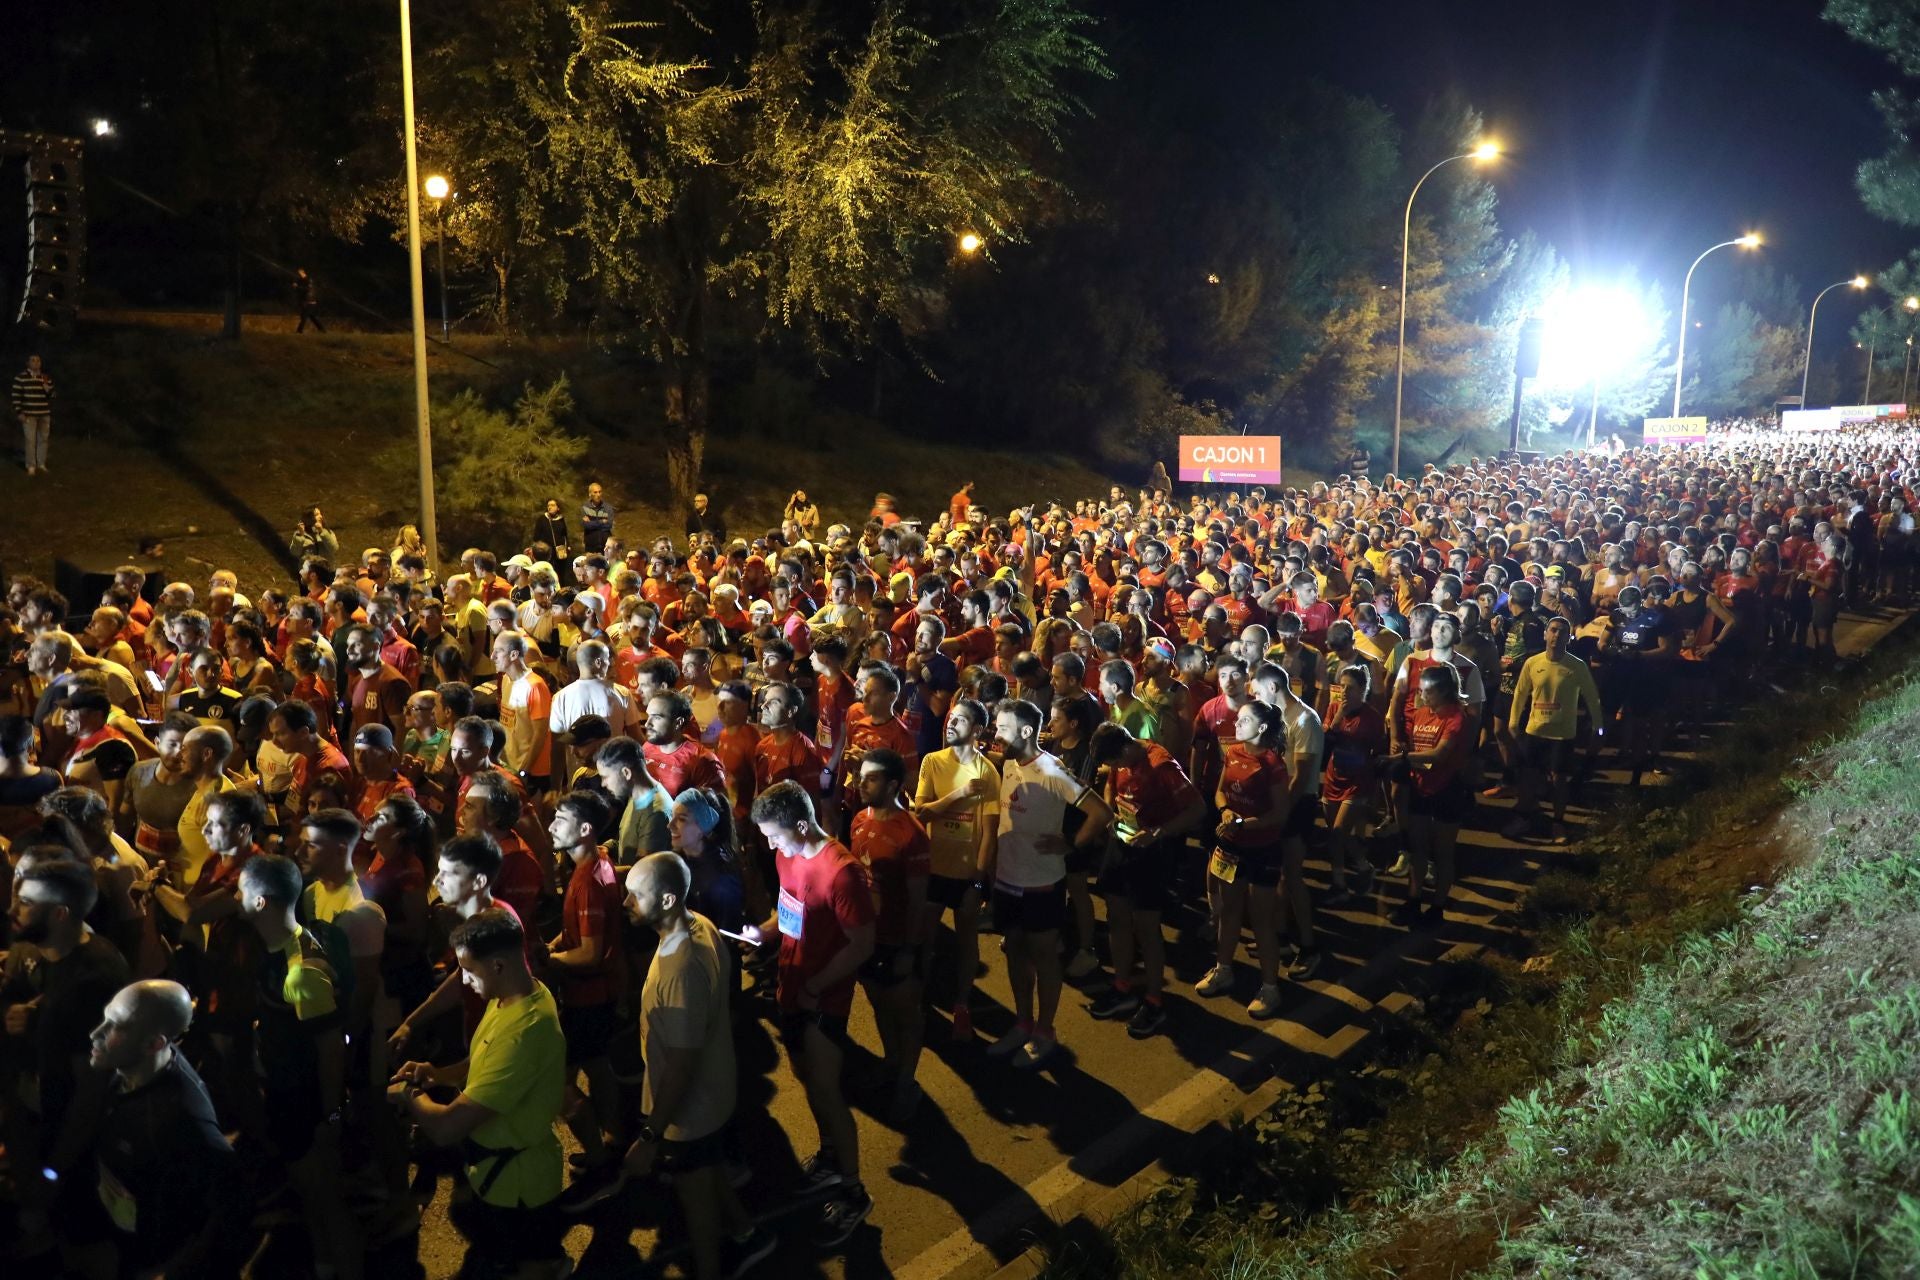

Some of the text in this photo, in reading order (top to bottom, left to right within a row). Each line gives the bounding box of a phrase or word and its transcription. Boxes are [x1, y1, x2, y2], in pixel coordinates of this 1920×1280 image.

[1651, 423, 1698, 433] CAJON 2
[1192, 446, 1265, 464] CAJON 1
[1418, 724, 1440, 734] UCLM
